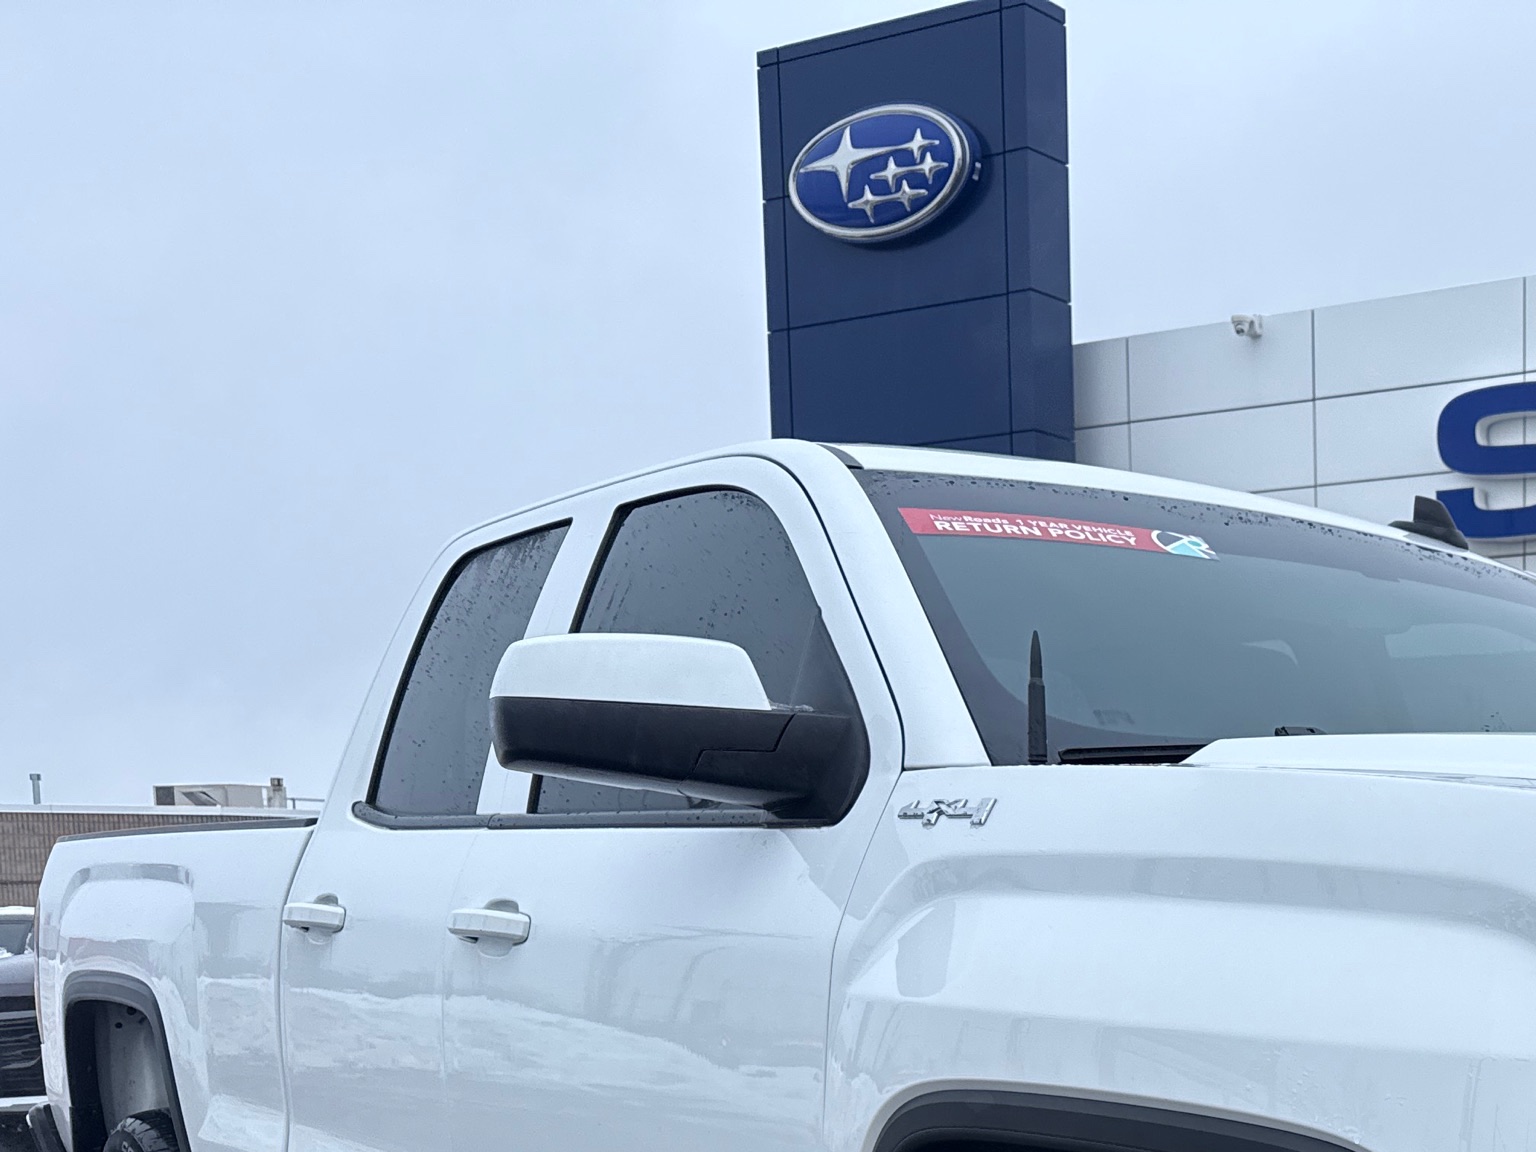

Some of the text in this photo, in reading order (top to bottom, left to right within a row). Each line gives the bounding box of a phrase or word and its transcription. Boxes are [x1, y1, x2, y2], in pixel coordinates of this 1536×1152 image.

[933, 520, 1136, 546] RETURN POLICY
[1027, 519, 1069, 530] YEAR
[1071, 523, 1134, 537] VEHICLE
